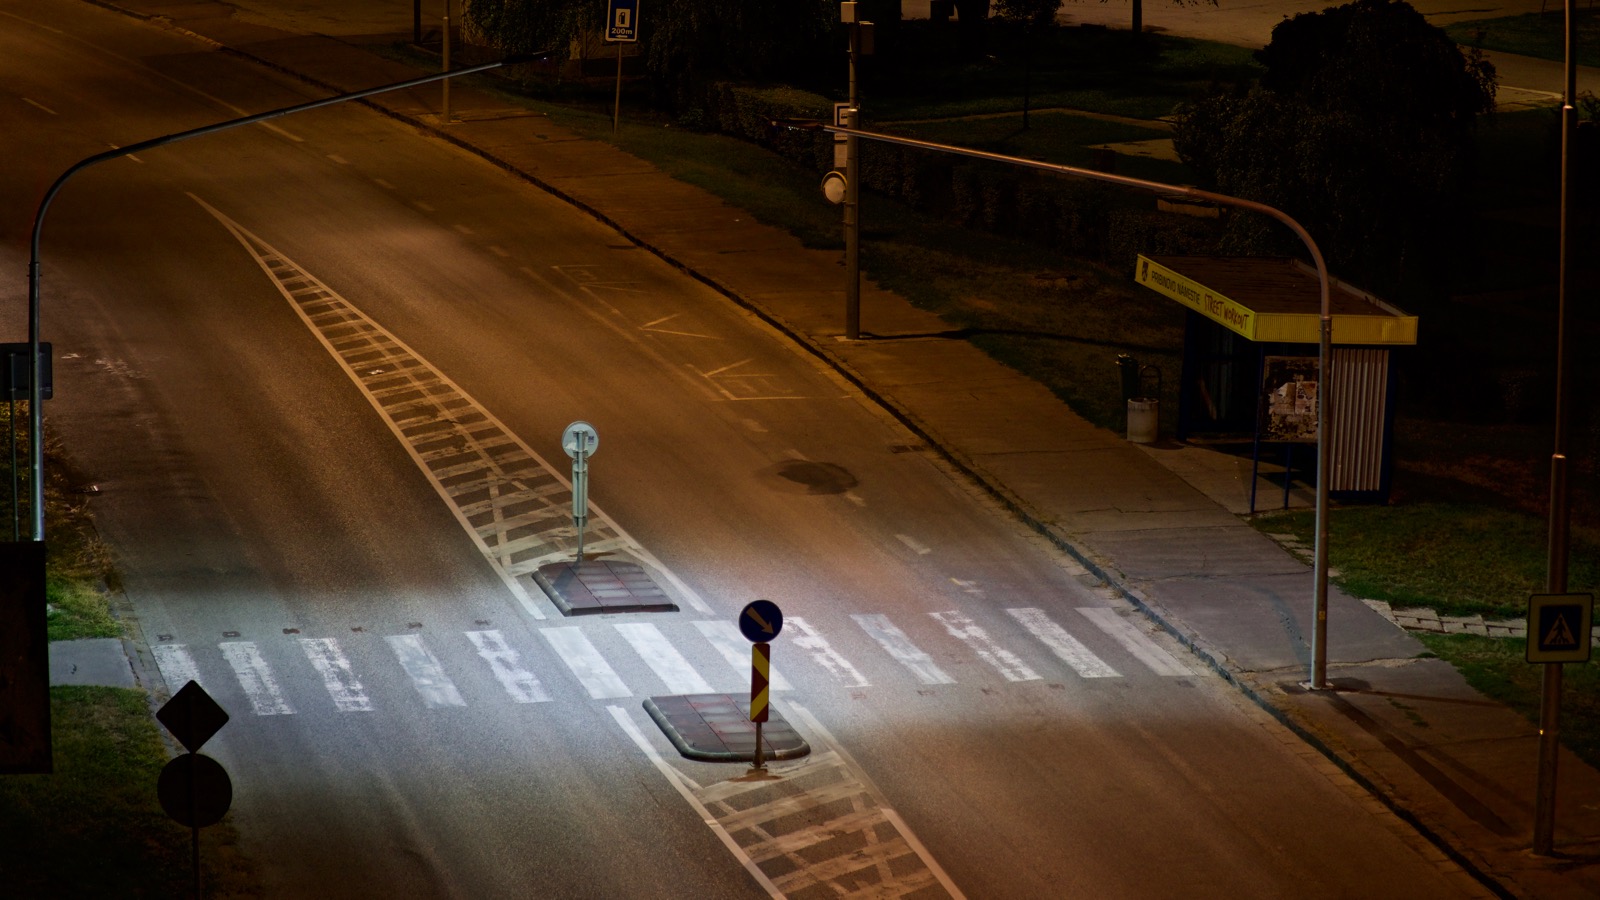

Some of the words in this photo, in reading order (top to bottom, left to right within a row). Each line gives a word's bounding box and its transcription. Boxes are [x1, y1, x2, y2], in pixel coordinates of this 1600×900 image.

[611, 27, 633, 35] 200m
[1151, 270, 1175, 292] PRIBINOVO
[1205, 294, 1224, 318] STREET
[1224, 306, 1249, 331] WORKOUT
